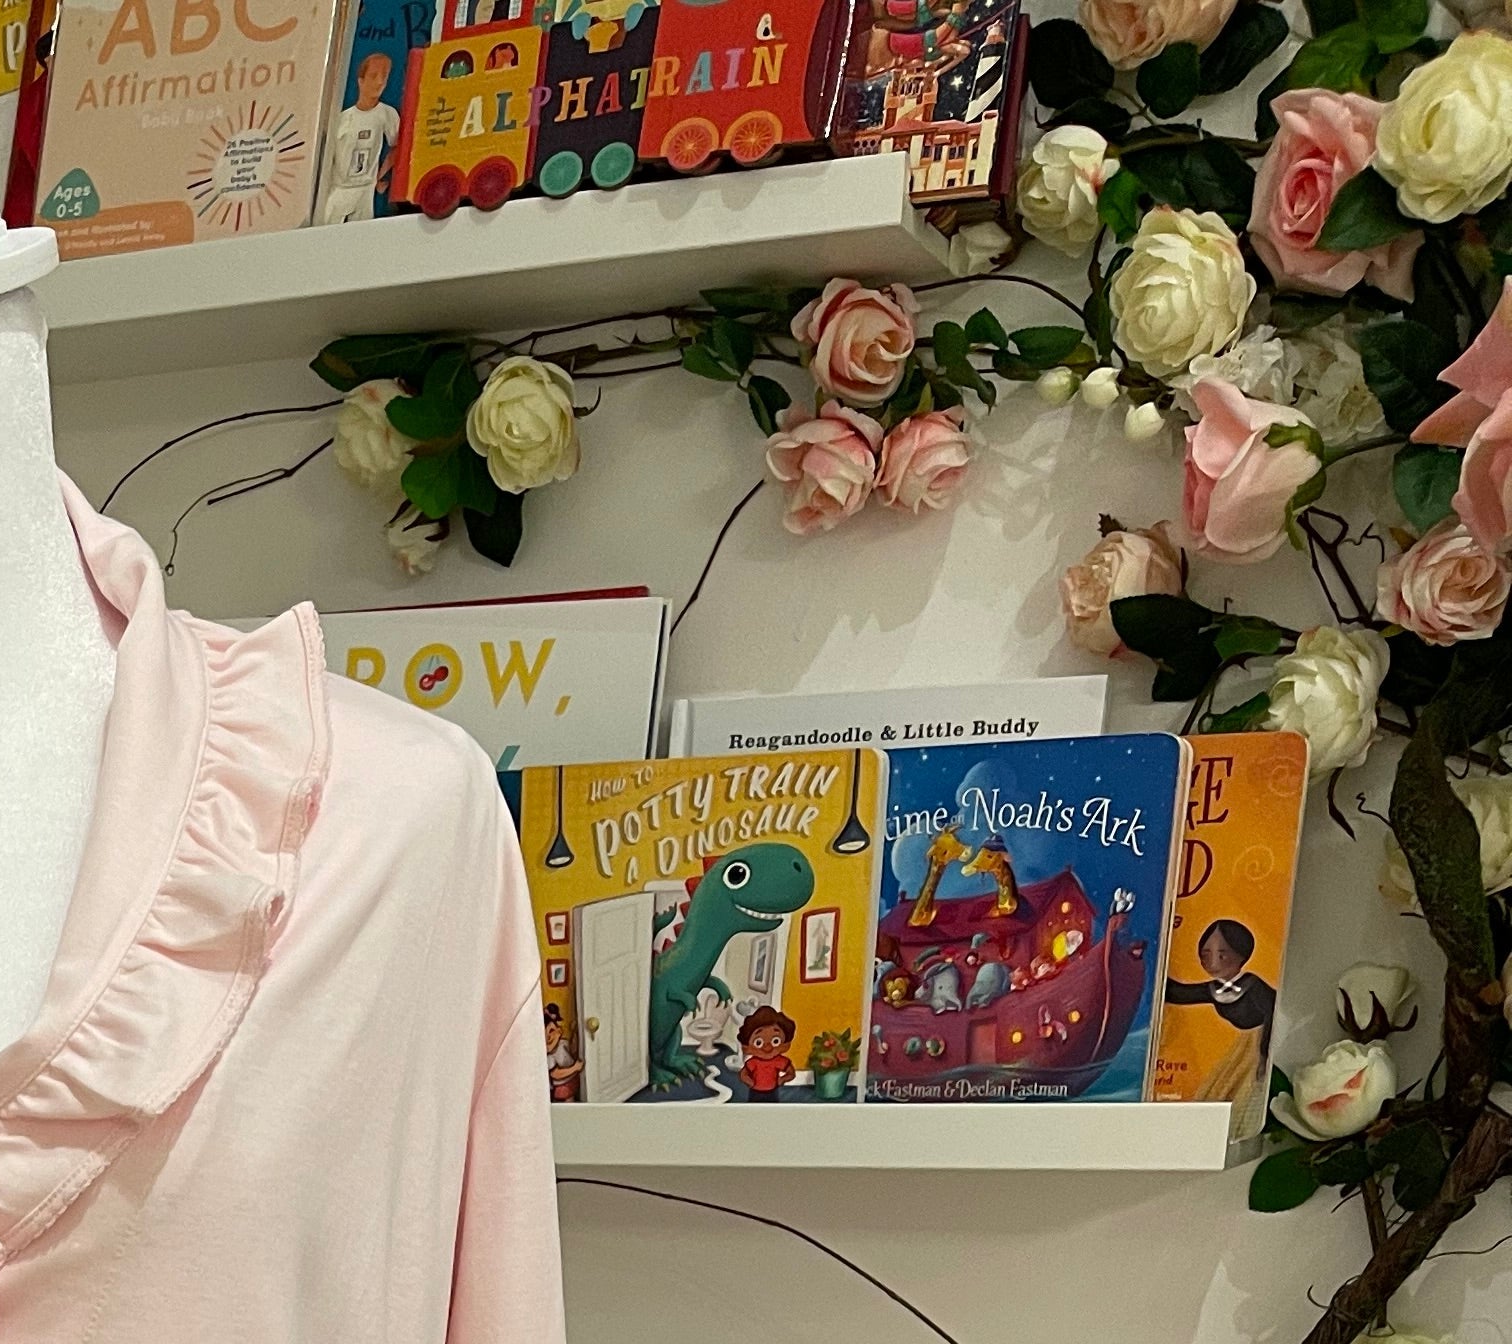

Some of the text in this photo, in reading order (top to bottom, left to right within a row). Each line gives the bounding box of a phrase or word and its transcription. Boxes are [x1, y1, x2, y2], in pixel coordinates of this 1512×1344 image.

[74, 57, 296, 111] Affirmation
[53, 185, 91, 202] Ages
[56, 201, 83, 218] 0-5
[729, 717, 1040, 750] Reagandoodle & Little Buddy
[634, 766, 653, 786] TO
[723, 761, 840, 802] TRAIN
[961, 787, 1074, 834] Noah's
[1078, 796, 1147, 856] Ark
[626, 803, 820, 884] A DINOSAUR
[882, 1079, 941, 1102] Eastman
[944, 1080, 955, 1097] &
[956, 1079, 1006, 1098] Declan
[1009, 1078, 1068, 1100] Eastman
